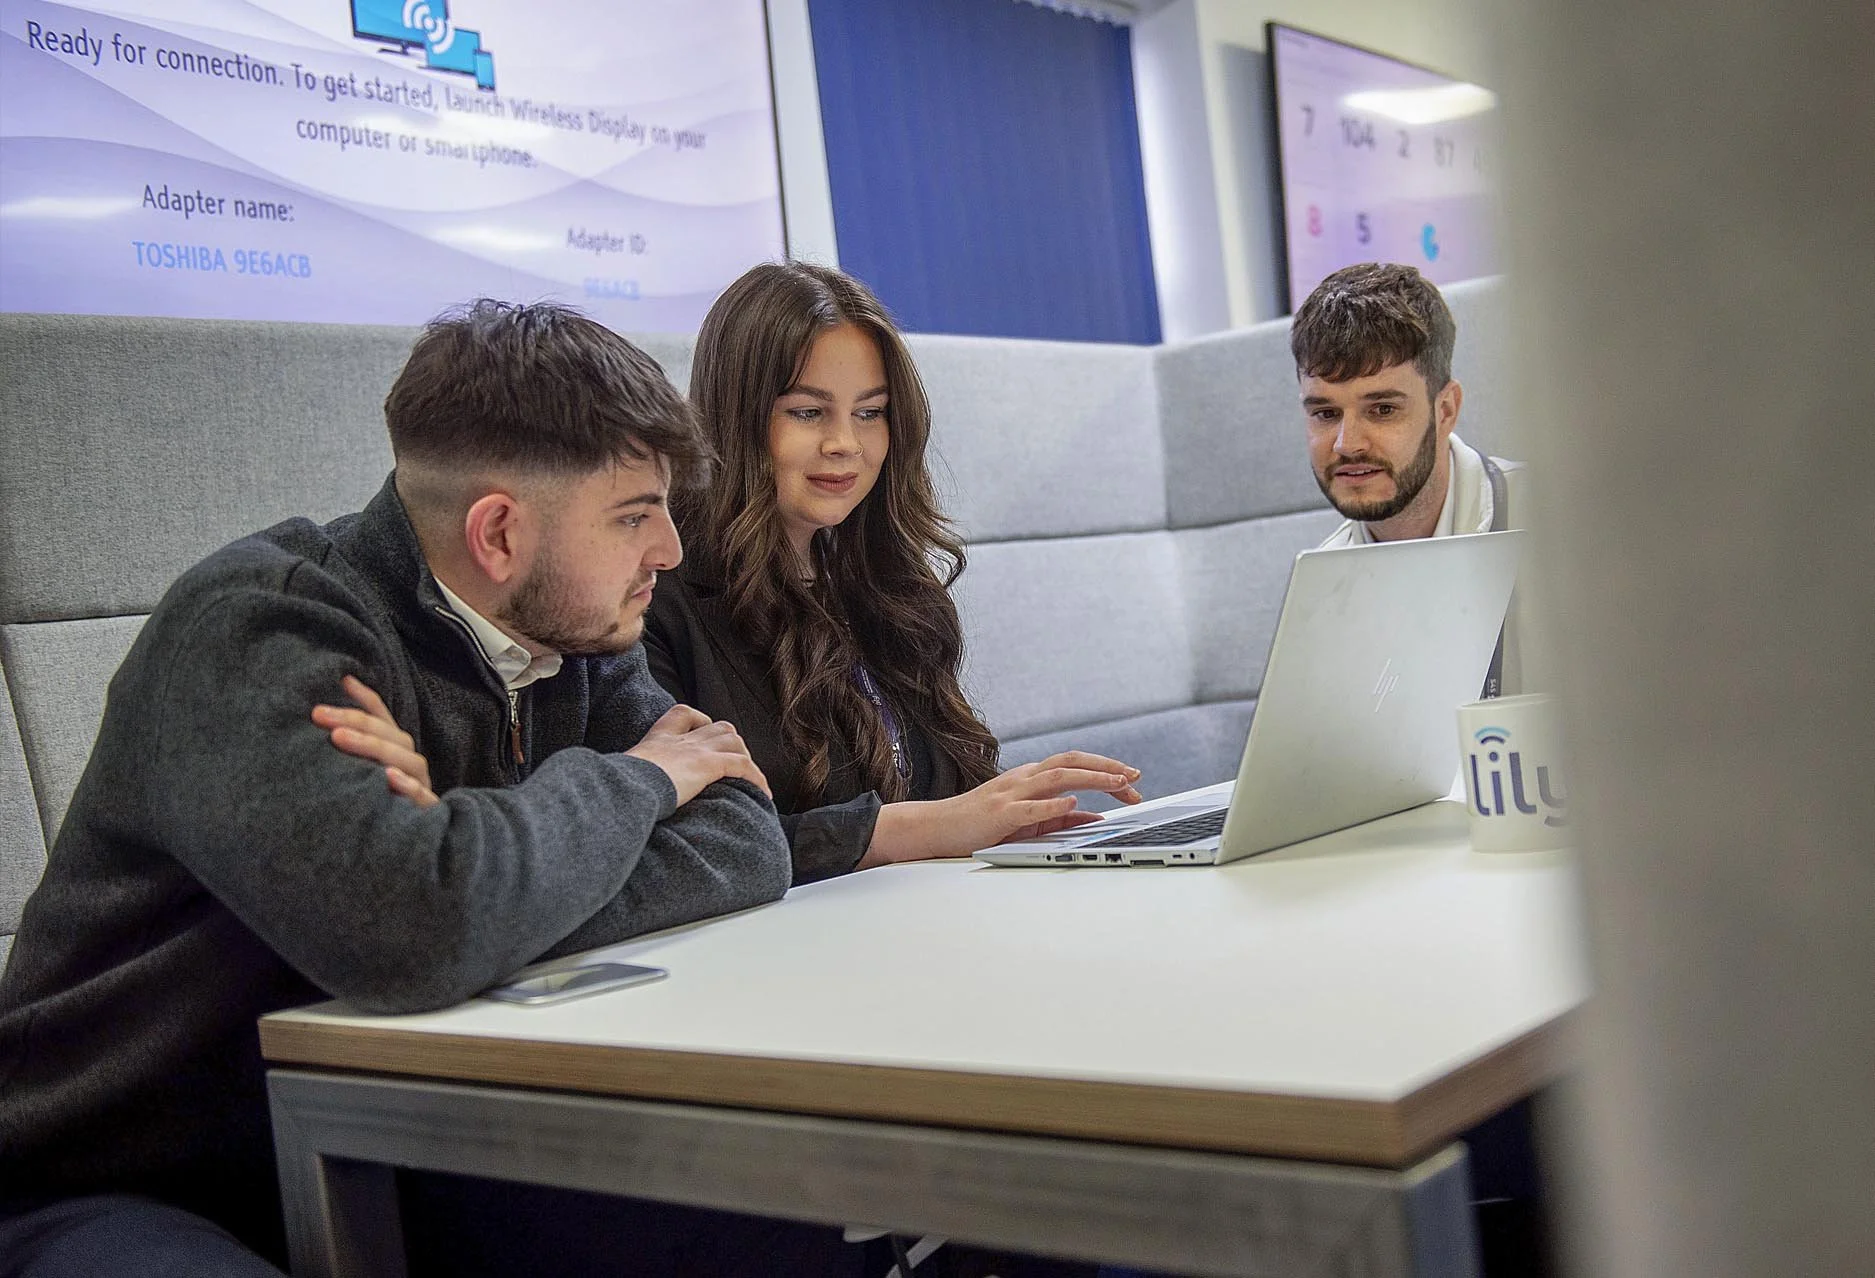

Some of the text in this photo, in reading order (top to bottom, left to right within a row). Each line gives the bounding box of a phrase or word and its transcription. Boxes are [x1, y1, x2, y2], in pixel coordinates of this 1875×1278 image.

[26, 19, 706, 152] Ready for connection. To get started, launch Wireless Display on your
[296, 119, 391, 151] computer
[399, 134, 417, 152] or
[142, 184, 294, 222] Adapter name:
[132, 241, 311, 278] TOSHIBA 9E6ACB
[567, 227, 624, 256] Adapter
